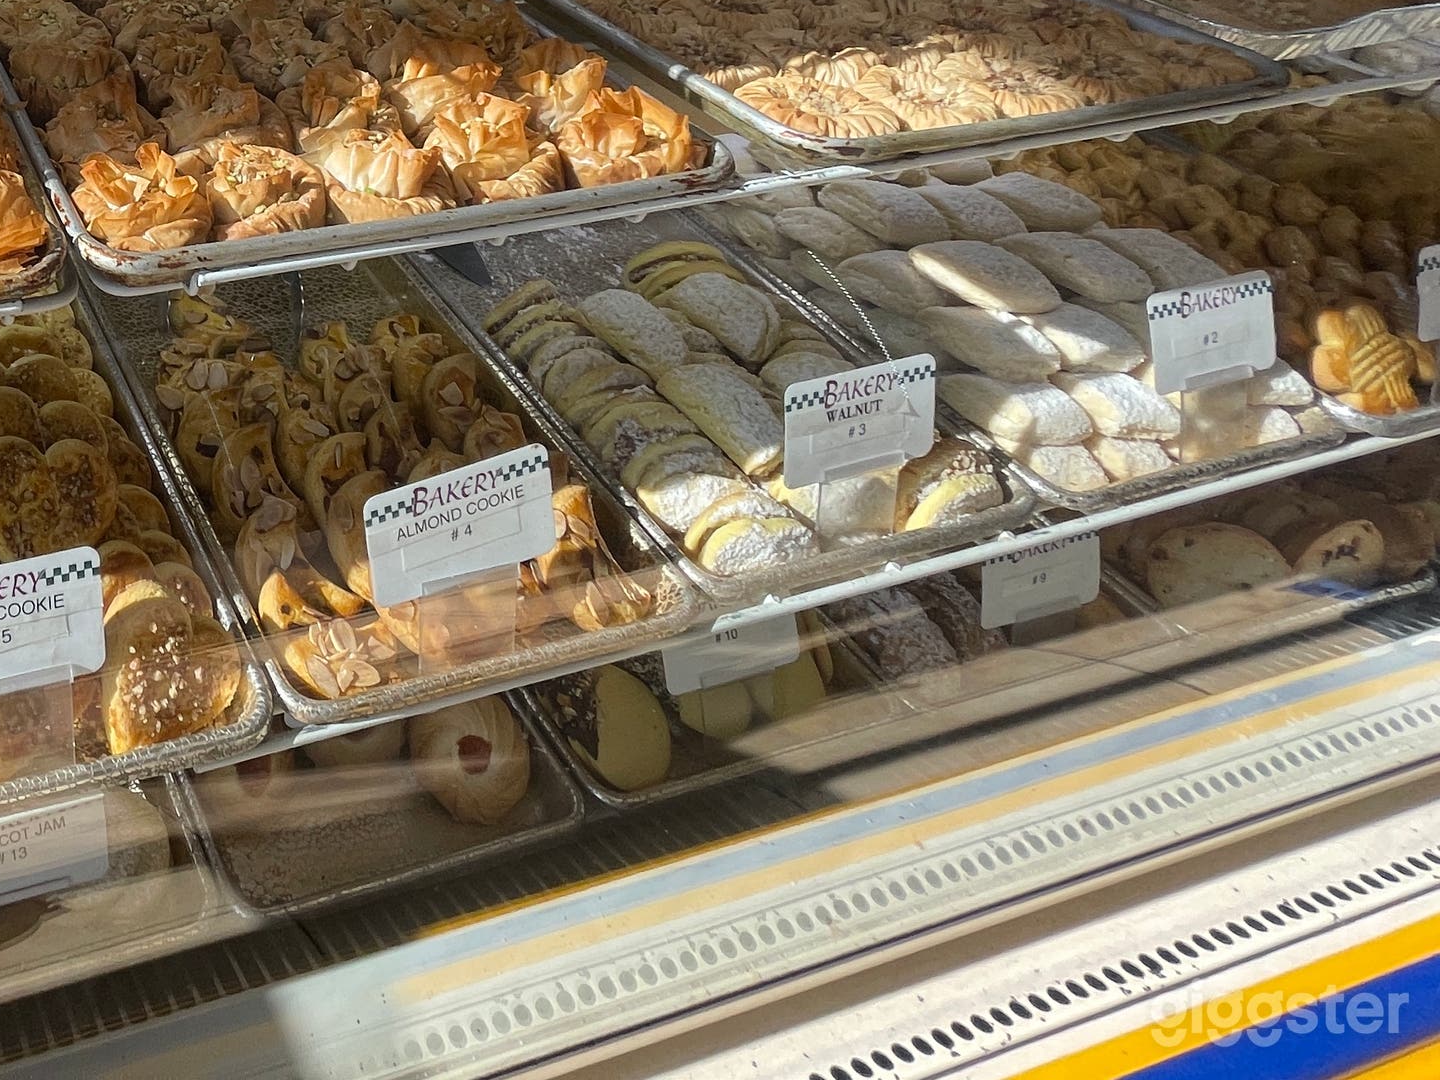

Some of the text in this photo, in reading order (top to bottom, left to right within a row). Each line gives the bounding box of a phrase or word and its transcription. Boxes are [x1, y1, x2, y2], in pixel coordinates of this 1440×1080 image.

[1179, 286, 1239, 318] BAKERY
[825, 372, 897, 409] BAKERY
[826, 399, 883, 423] WALNUT
[412, 467, 503, 518] BAKERY
[397, 484, 525, 541] ALMOND COOKIE
[35, 816, 66, 836] JAM
